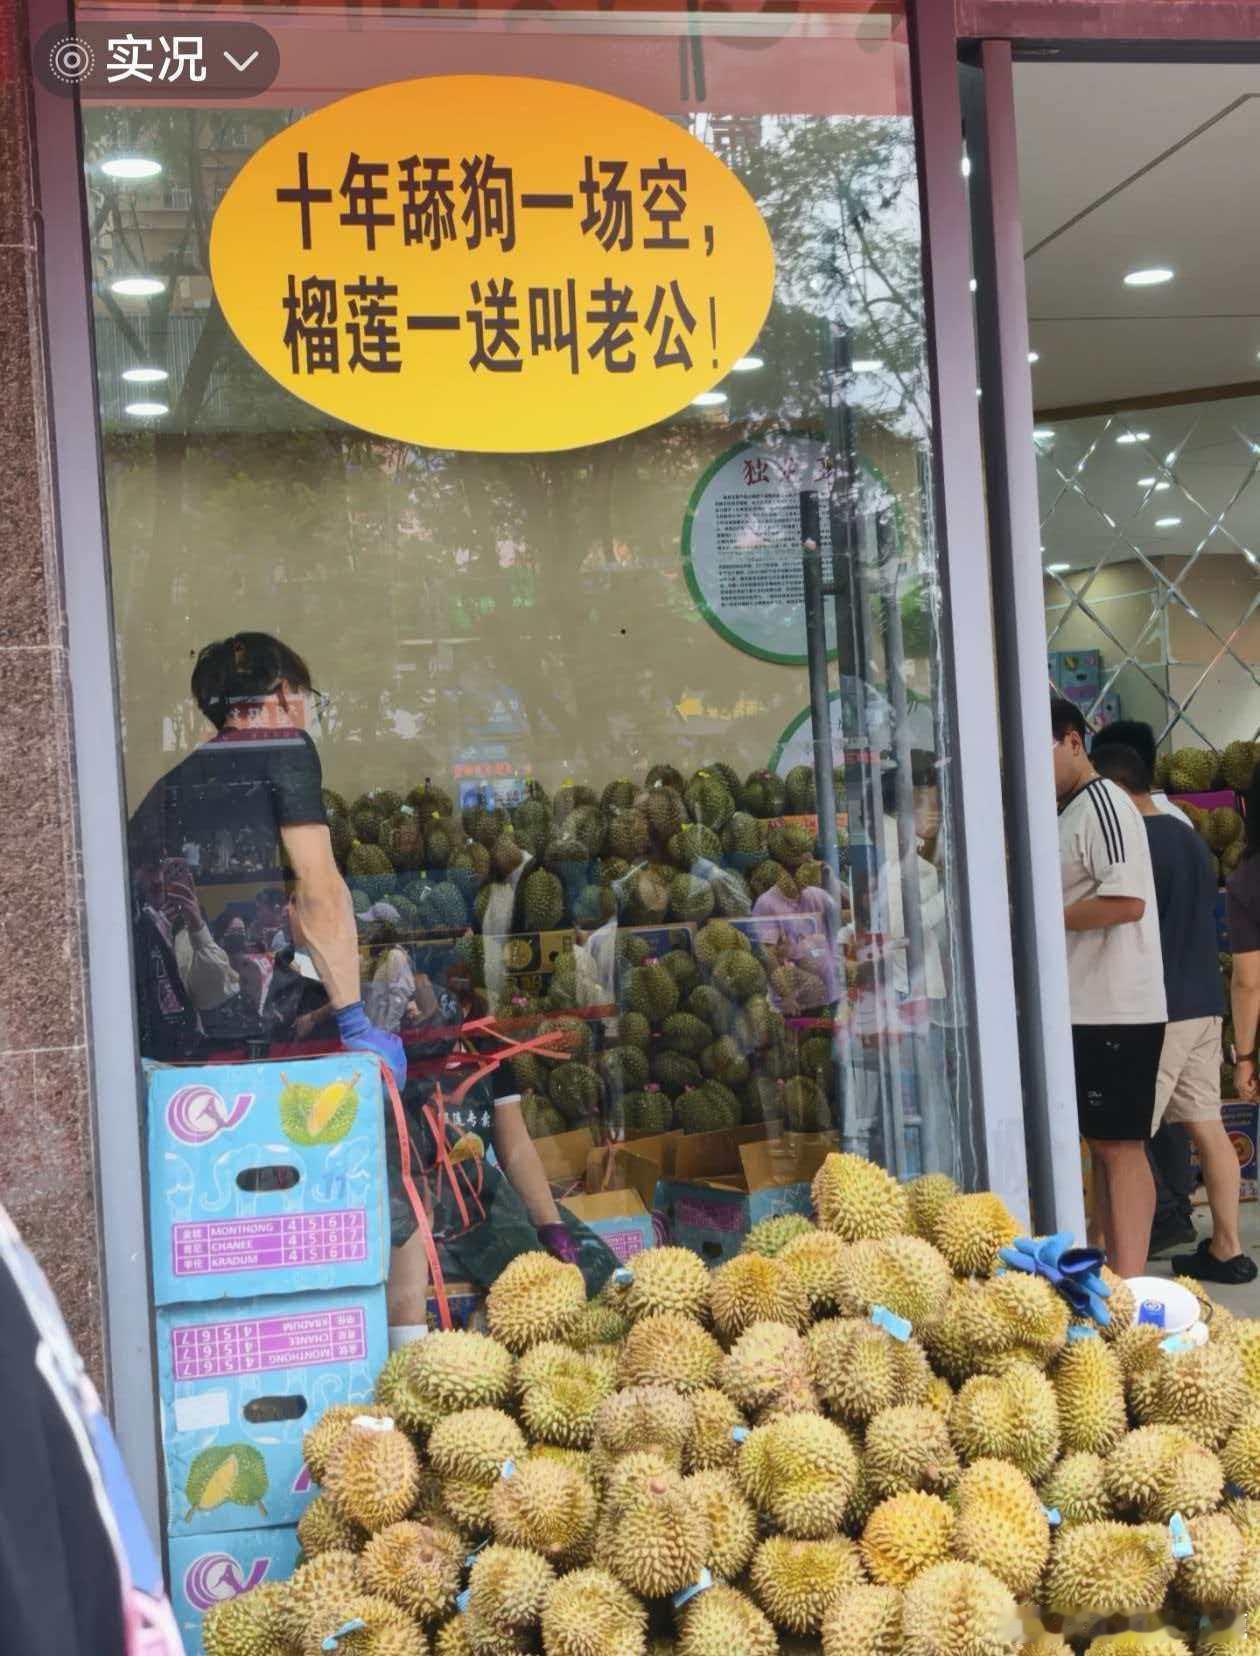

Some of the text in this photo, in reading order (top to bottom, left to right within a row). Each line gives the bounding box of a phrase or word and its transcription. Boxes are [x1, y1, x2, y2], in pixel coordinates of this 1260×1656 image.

[276, 151, 715, 256] 十年舔狗一场空，
[281, 274, 719, 375] 榴莲一送叫老公！
[211, 1222, 274, 1236] MONTHONG
[288, 1220, 297, 1231] 4
[309, 1217, 317, 1229] 5
[328, 1216, 337, 1227] 6
[350, 1215, 357, 1226] 7
[288, 1235, 297, 1246] 4
[309, 1233, 317, 1244] 5
[329, 1231, 337, 1242] 6
[350, 1230, 357, 1241] 7
[212, 1255, 258, 1267] KRADUM
[288, 1250, 297, 1261] 4
[309, 1249, 317, 1260] 5
[329, 1247, 338, 1258] 6
[351, 1245, 358, 1256] 7
[202, 1331, 210, 1342] 6
[223, 1328, 231, 1339] 5
[245, 1326, 252, 1337] 4
[182, 1333, 189, 1345] 7
[203, 1346, 211, 1357] 6
[225, 1345, 232, 1356] 5
[245, 1342, 253, 1353] 4
[183, 1349, 190, 1360] 7
[269, 1348, 330, 1364] MONTHONG
[204, 1362, 212, 1373] 6
[225, 1360, 233, 1371] 5
[246, 1357, 254, 1368] 4
[184, 1365, 191, 1376] 7
